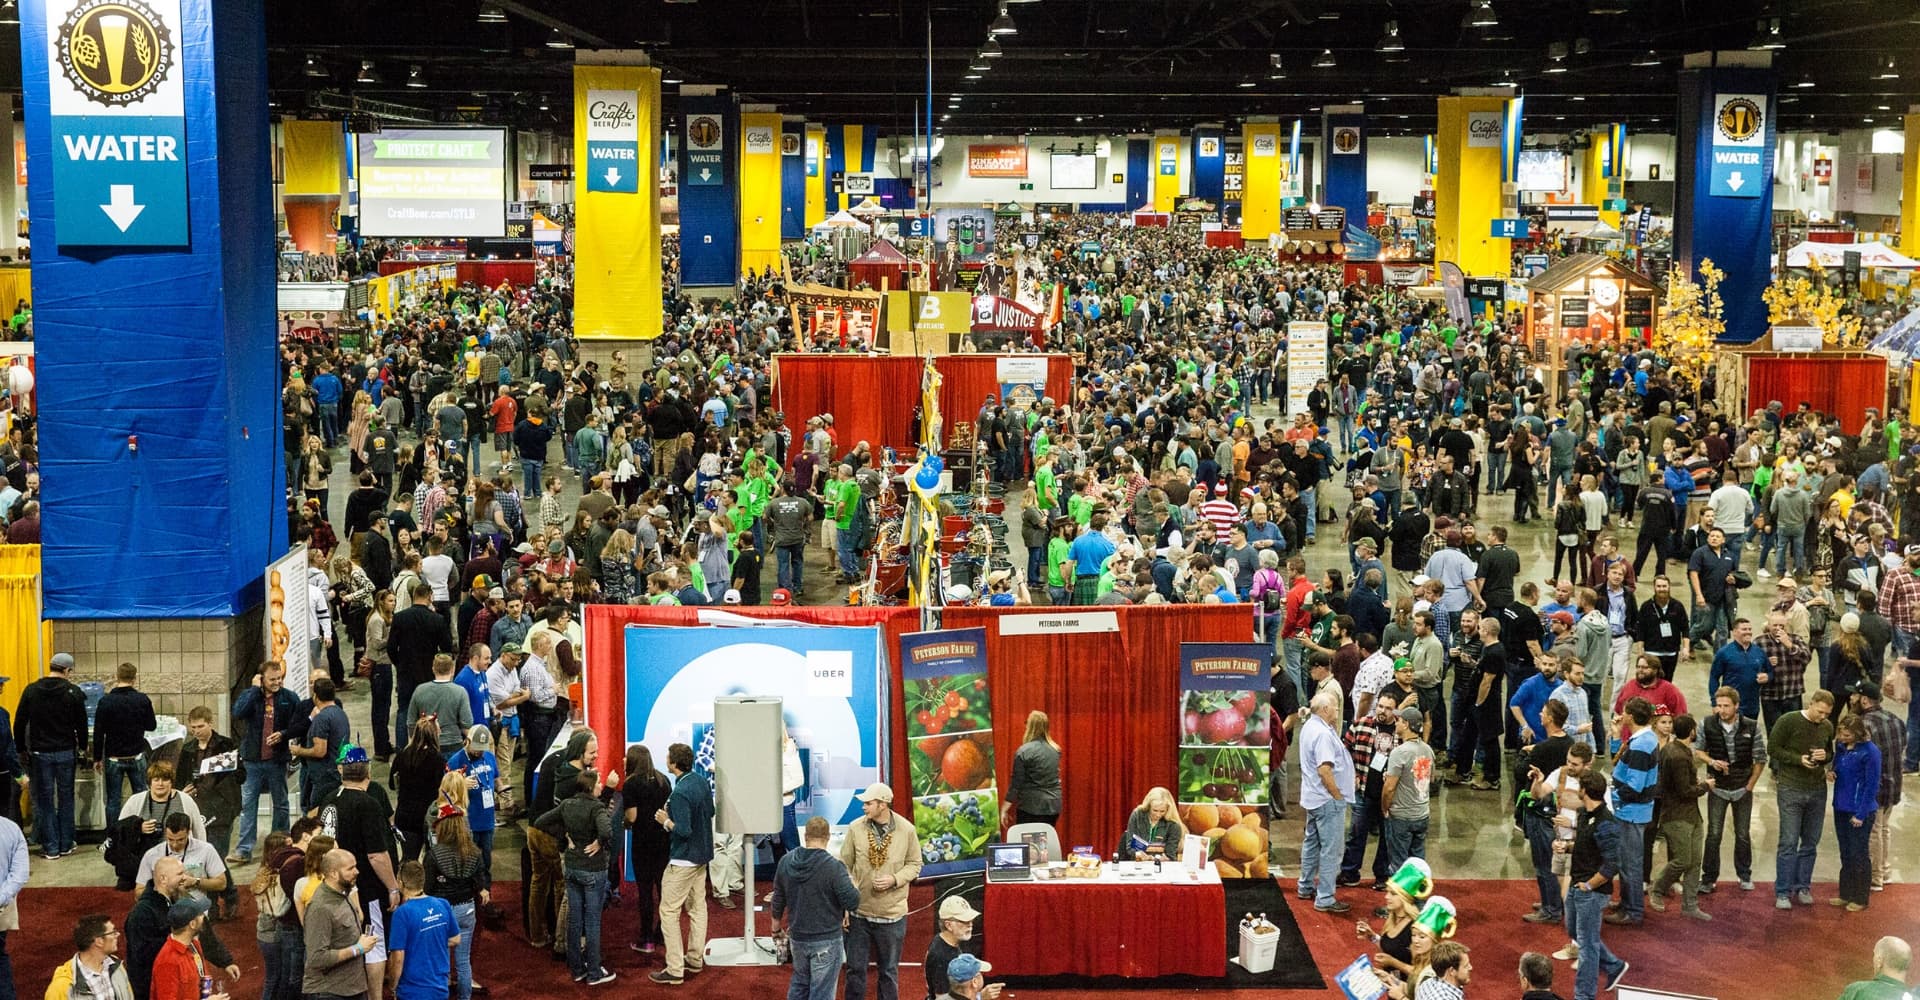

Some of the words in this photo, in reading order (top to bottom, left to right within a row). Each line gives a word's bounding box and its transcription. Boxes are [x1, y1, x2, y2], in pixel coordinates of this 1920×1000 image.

[589, 100, 635, 129] Craft
[1469, 119, 1502, 139] Craft
[62, 134, 179, 161] WATER
[387, 142, 434, 157] PROTECT
[437, 143, 475, 157] CRAFT
[591, 148, 635, 160] WATER
[690, 154, 721, 163] WATER
[1714, 152, 1760, 165] WATER
[530, 169, 561, 178] carhartt
[911, 219, 922, 232] G
[1503, 220, 1516, 232] H
[831, 297, 875, 309] BREWING
[919, 295, 941, 319] B
[995, 300, 1037, 328] JUSTICE
[1038, 620, 1062, 628] PETERSON
[1062, 619, 1080, 627] FARMS
[913, 645, 950, 661] PETERSON
[950, 643, 975, 655] FARMS
[1194, 660, 1232, 672] PETERSON
[1232, 659, 1258, 672] FARMS
[813, 669, 846, 679] UBER
